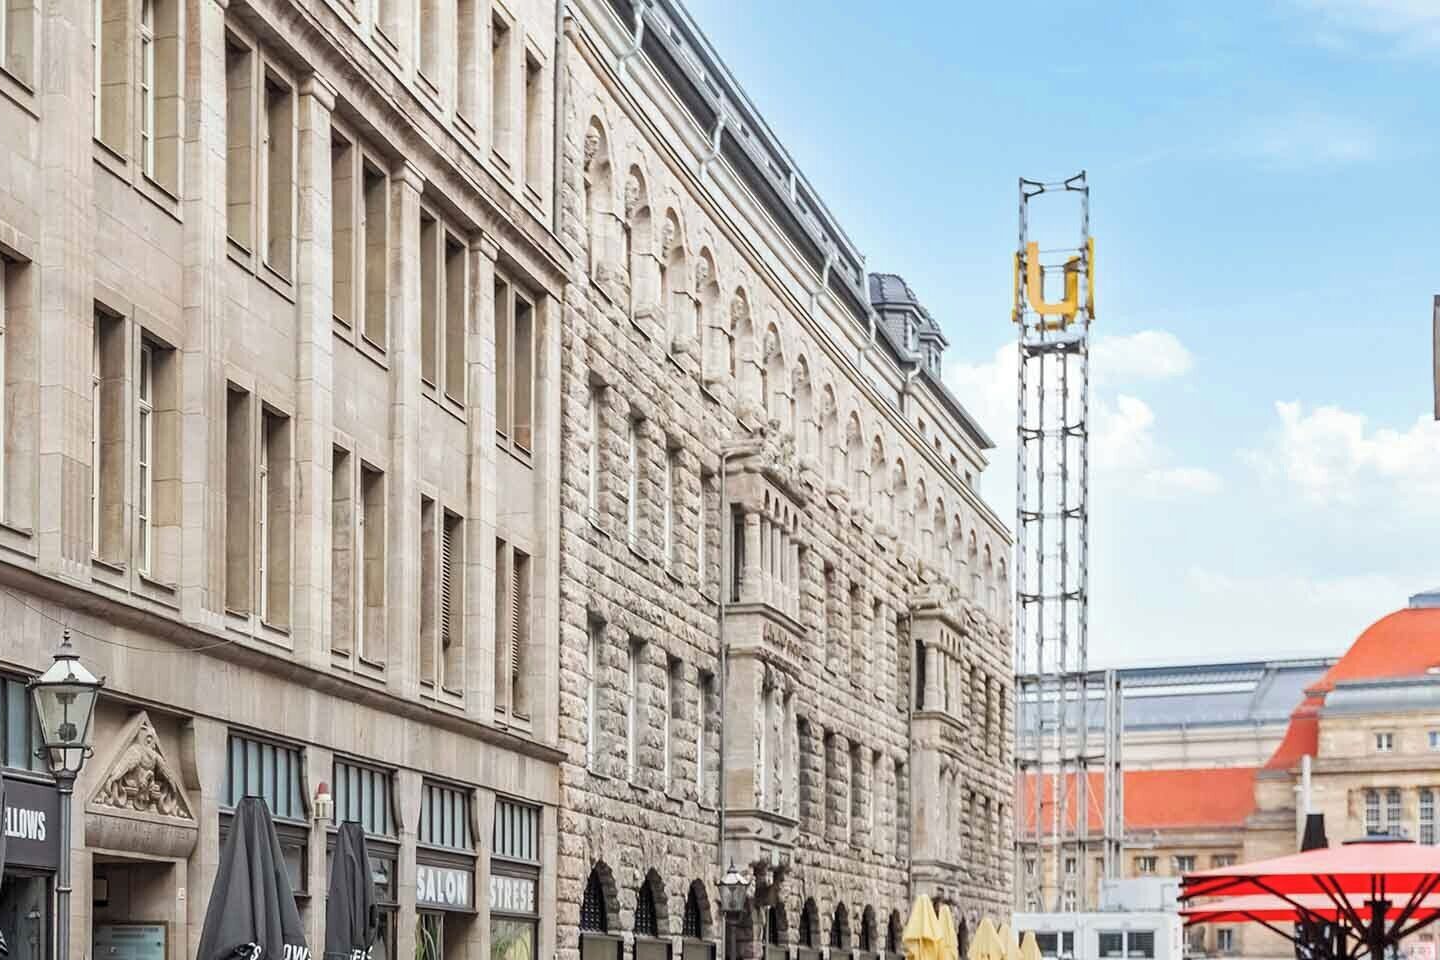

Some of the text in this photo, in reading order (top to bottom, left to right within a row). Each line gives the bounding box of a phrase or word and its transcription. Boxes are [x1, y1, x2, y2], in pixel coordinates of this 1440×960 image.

[4, 807, 46, 841] LLOWS
[416, 866, 468, 905] SALON
[489, 877, 535, 912] STRESE
